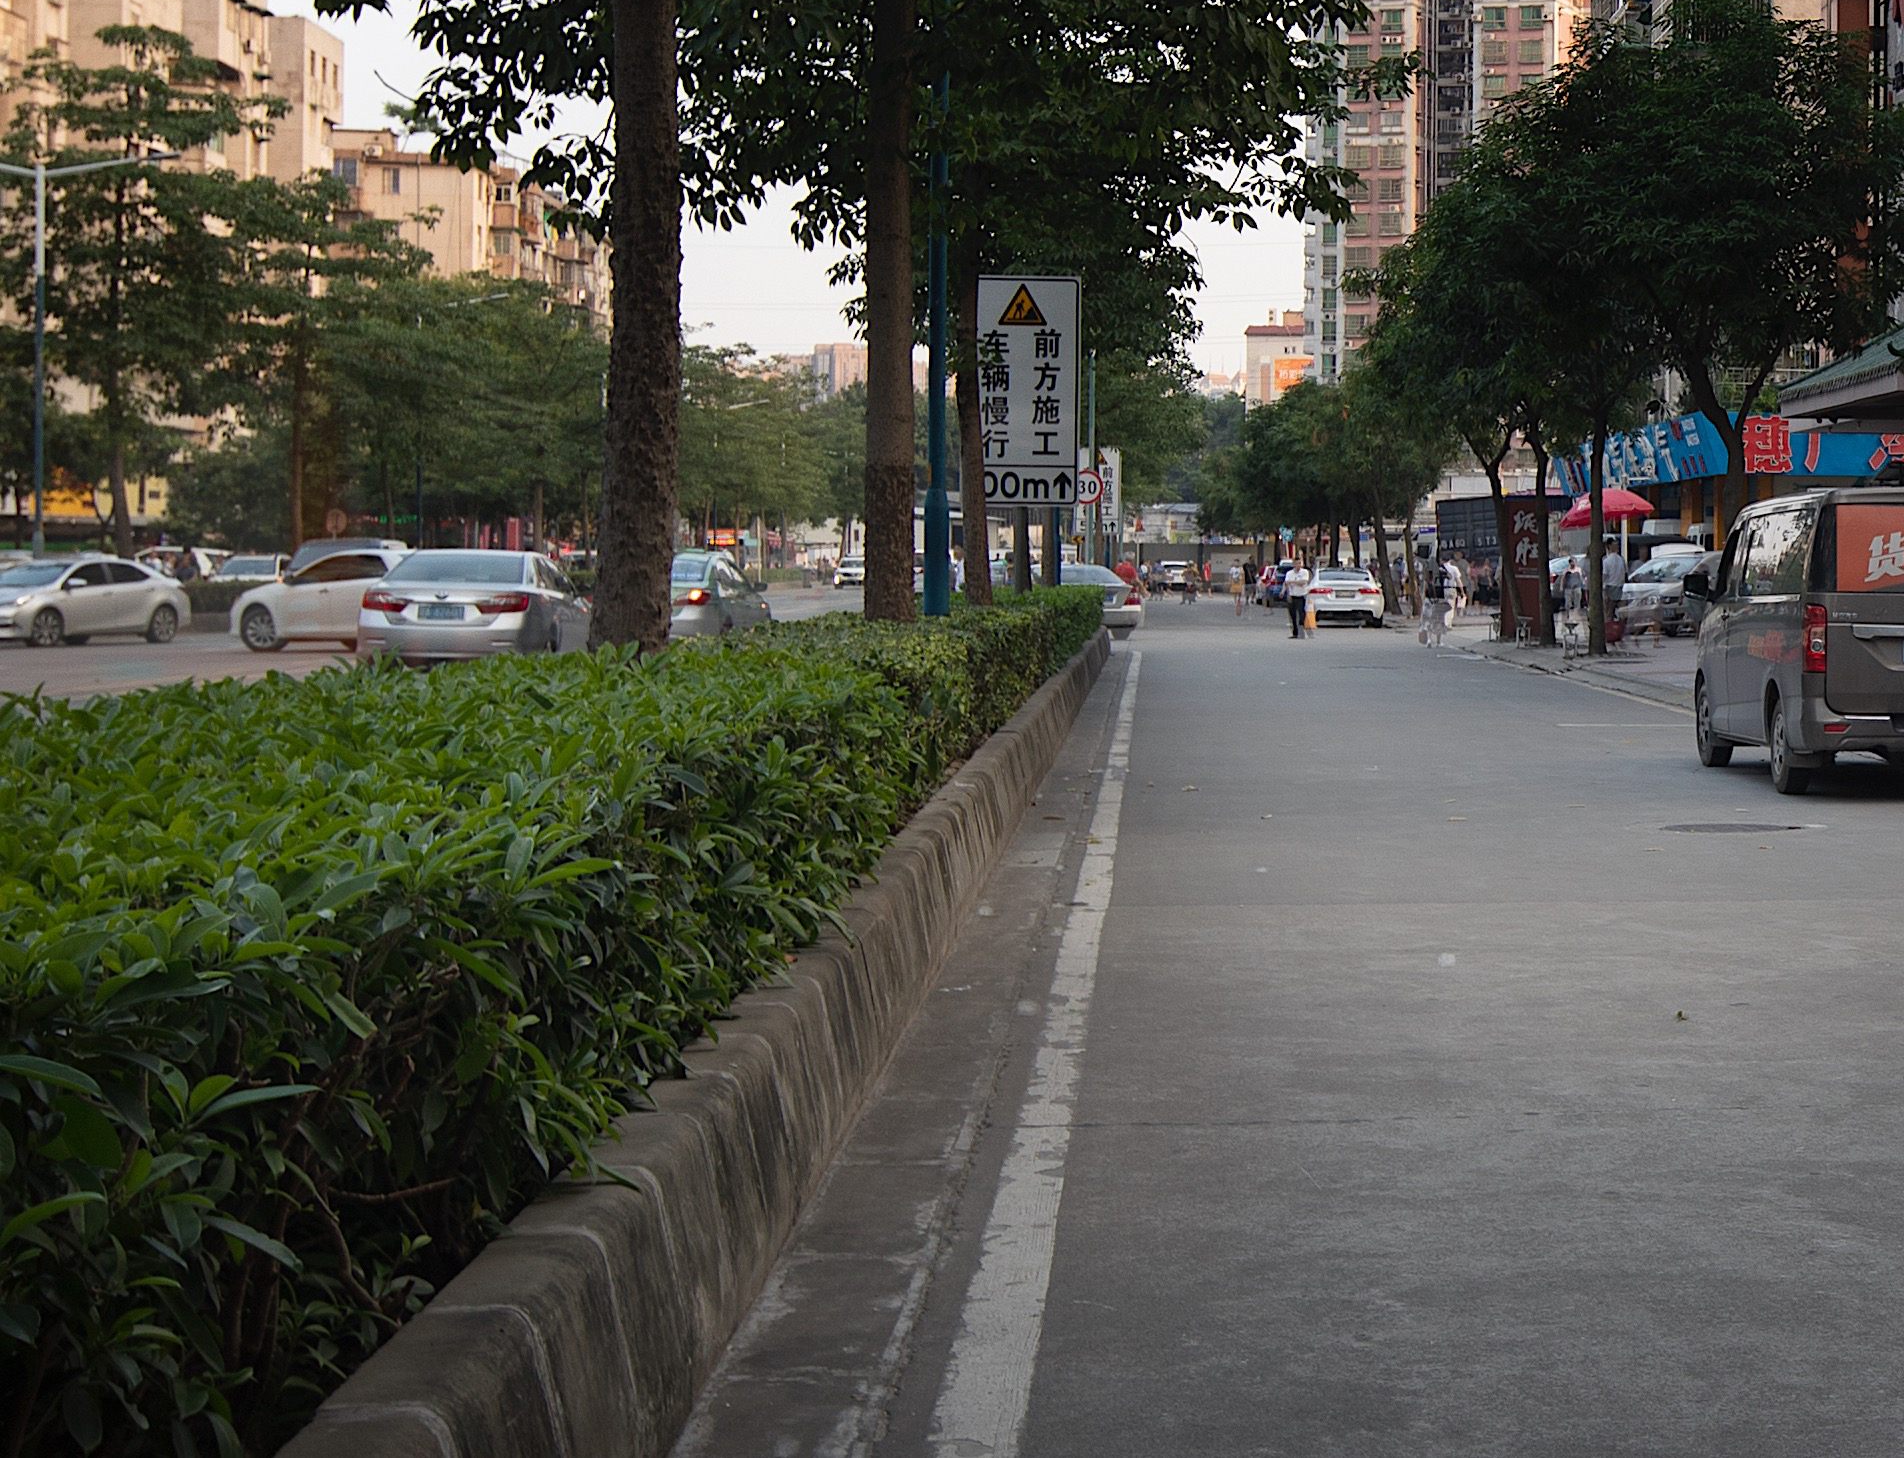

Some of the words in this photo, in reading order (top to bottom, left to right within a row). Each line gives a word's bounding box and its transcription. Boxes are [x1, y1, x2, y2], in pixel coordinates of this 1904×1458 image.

[981, 329, 1010, 458] 车辆慢行
[1032, 328, 1061, 455] 前方施工
[1079, 480, 1097, 494] 30
